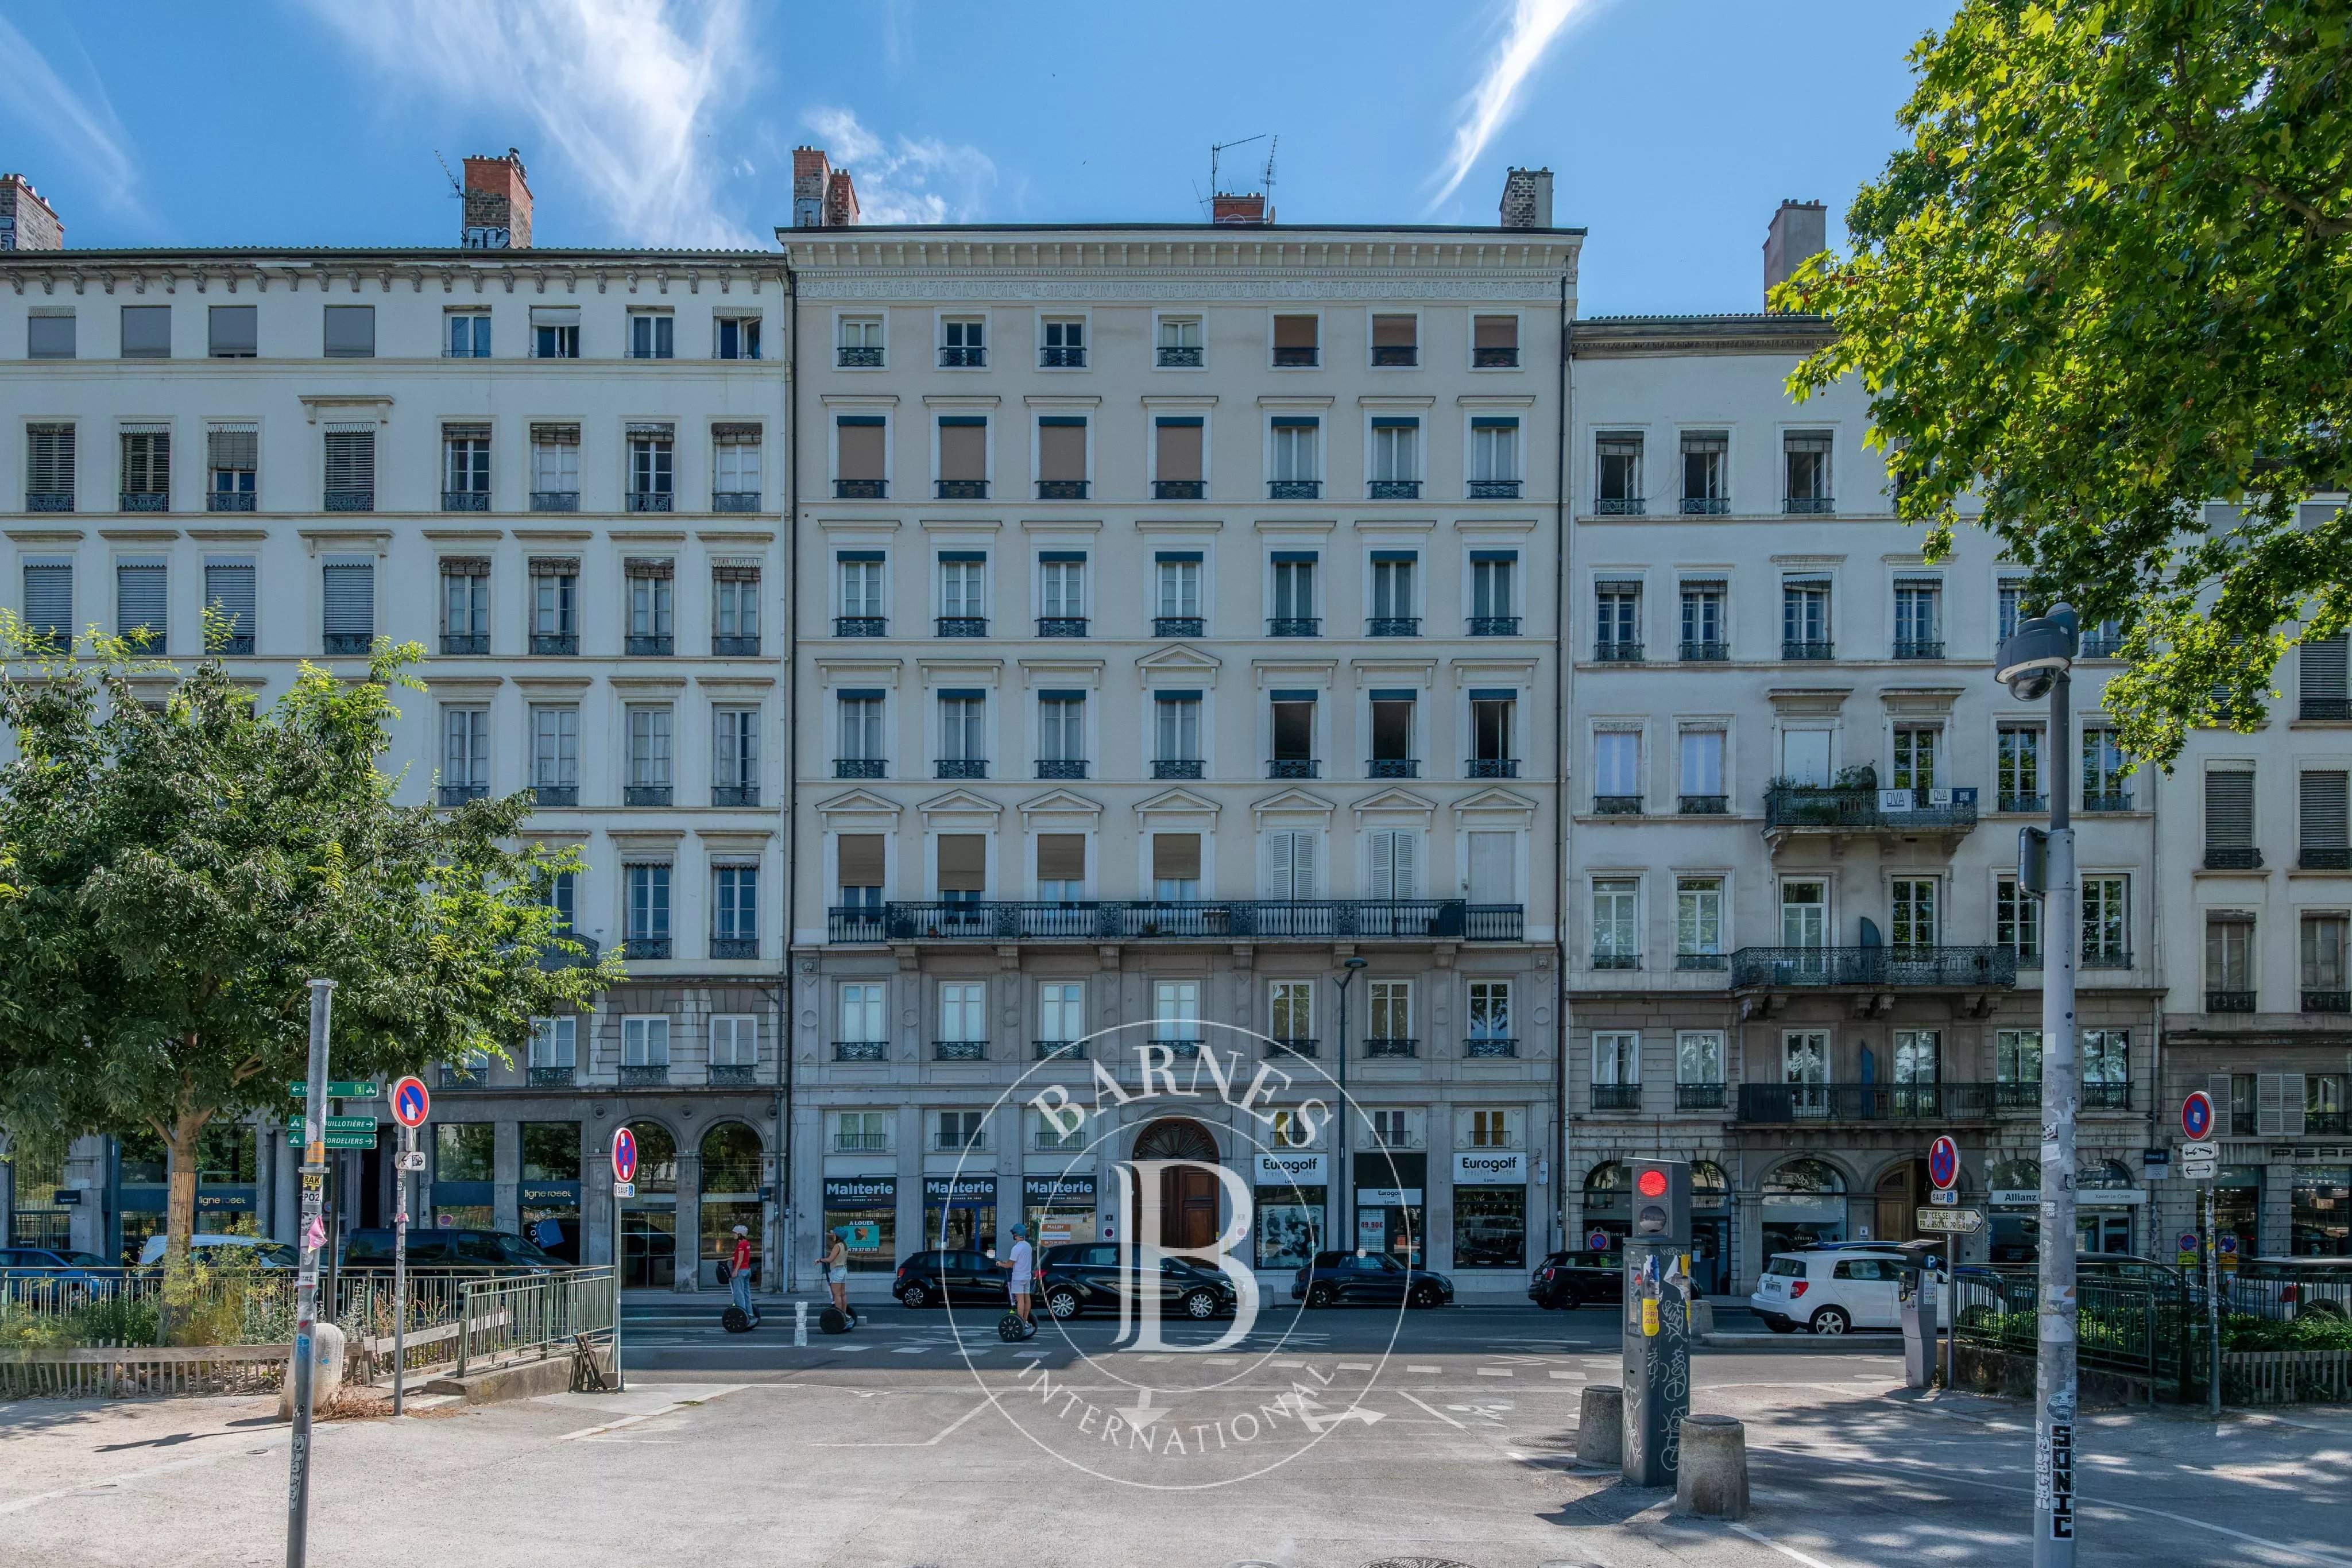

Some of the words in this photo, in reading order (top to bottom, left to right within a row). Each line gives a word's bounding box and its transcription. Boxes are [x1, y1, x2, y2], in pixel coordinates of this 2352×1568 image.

[1886, 792, 1905, 804] DVA
[1934, 789, 1947, 799] DVA
[1263, 1157, 1317, 1174] Eurogolf
[1462, 1156, 1517, 1172] Eurogolf
[617, 1185, 628, 1194] SAUF
[827, 1183, 893, 1195] Maliterie
[927, 1181, 994, 1194] Maliterie
[1026, 1181, 1093, 1193] Maliterie
[524, 1189, 547, 1199] ligne
[2004, 1193, 2037, 1201] Allianz
[199, 1196, 220, 1206] ligne
[1928, 1255, 1936, 1268] P
[2052, 1425, 2073, 1538] SONIC
